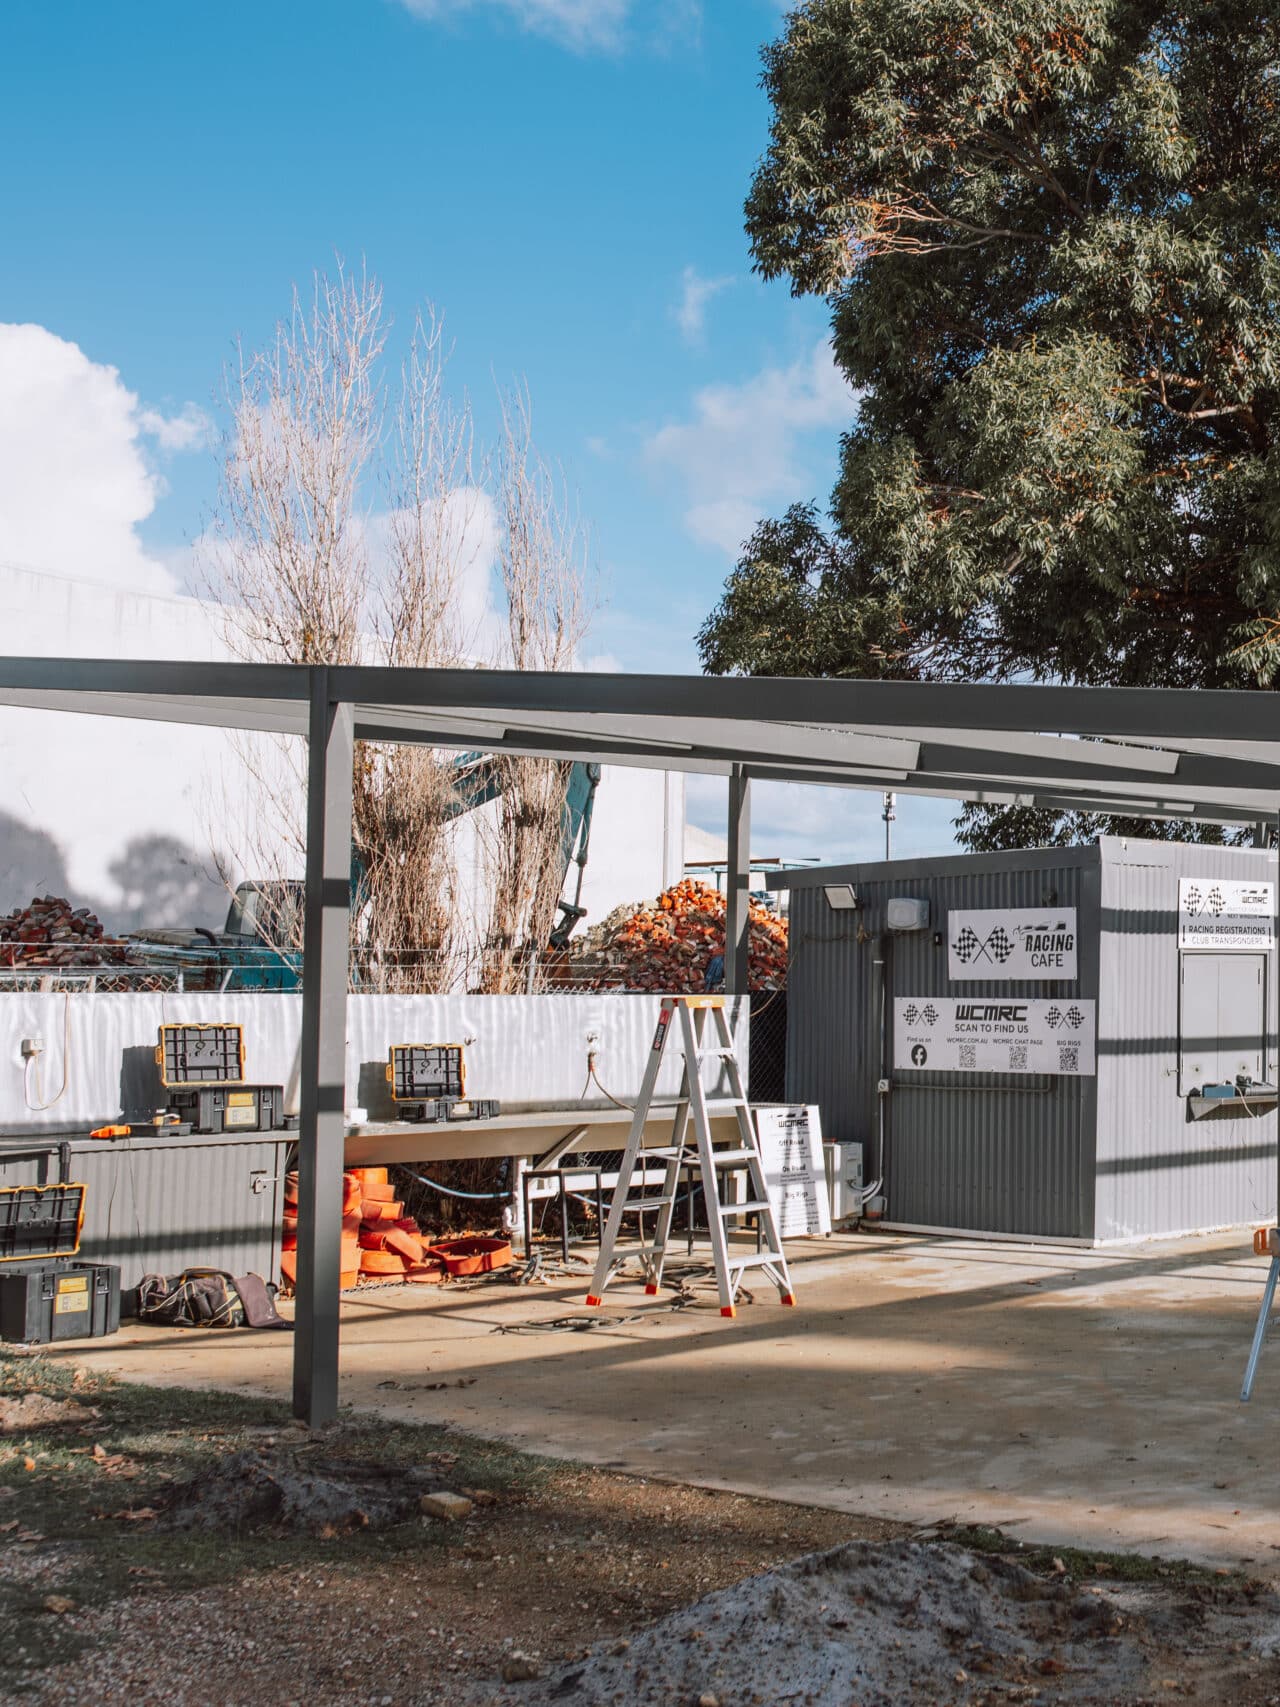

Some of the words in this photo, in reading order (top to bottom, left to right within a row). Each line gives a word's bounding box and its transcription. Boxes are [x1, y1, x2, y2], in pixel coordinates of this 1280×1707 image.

[1189, 925, 1214, 934] RACING
[1216, 926, 1266, 935] REGISTRATIONS
[1025, 934, 1074, 952] RACING
[1192, 936, 1209, 944] CLUB
[1211, 937, 1263, 945] TRANSPONDERS
[1031, 953, 1064, 967] CAFE
[955, 1005, 1028, 1021] WCMRC
[955, 1024, 978, 1032] SCAN
[981, 1024, 992, 1032] TO
[994, 1024, 1015, 1033] FIND
[1017, 1025, 1029, 1033] US
